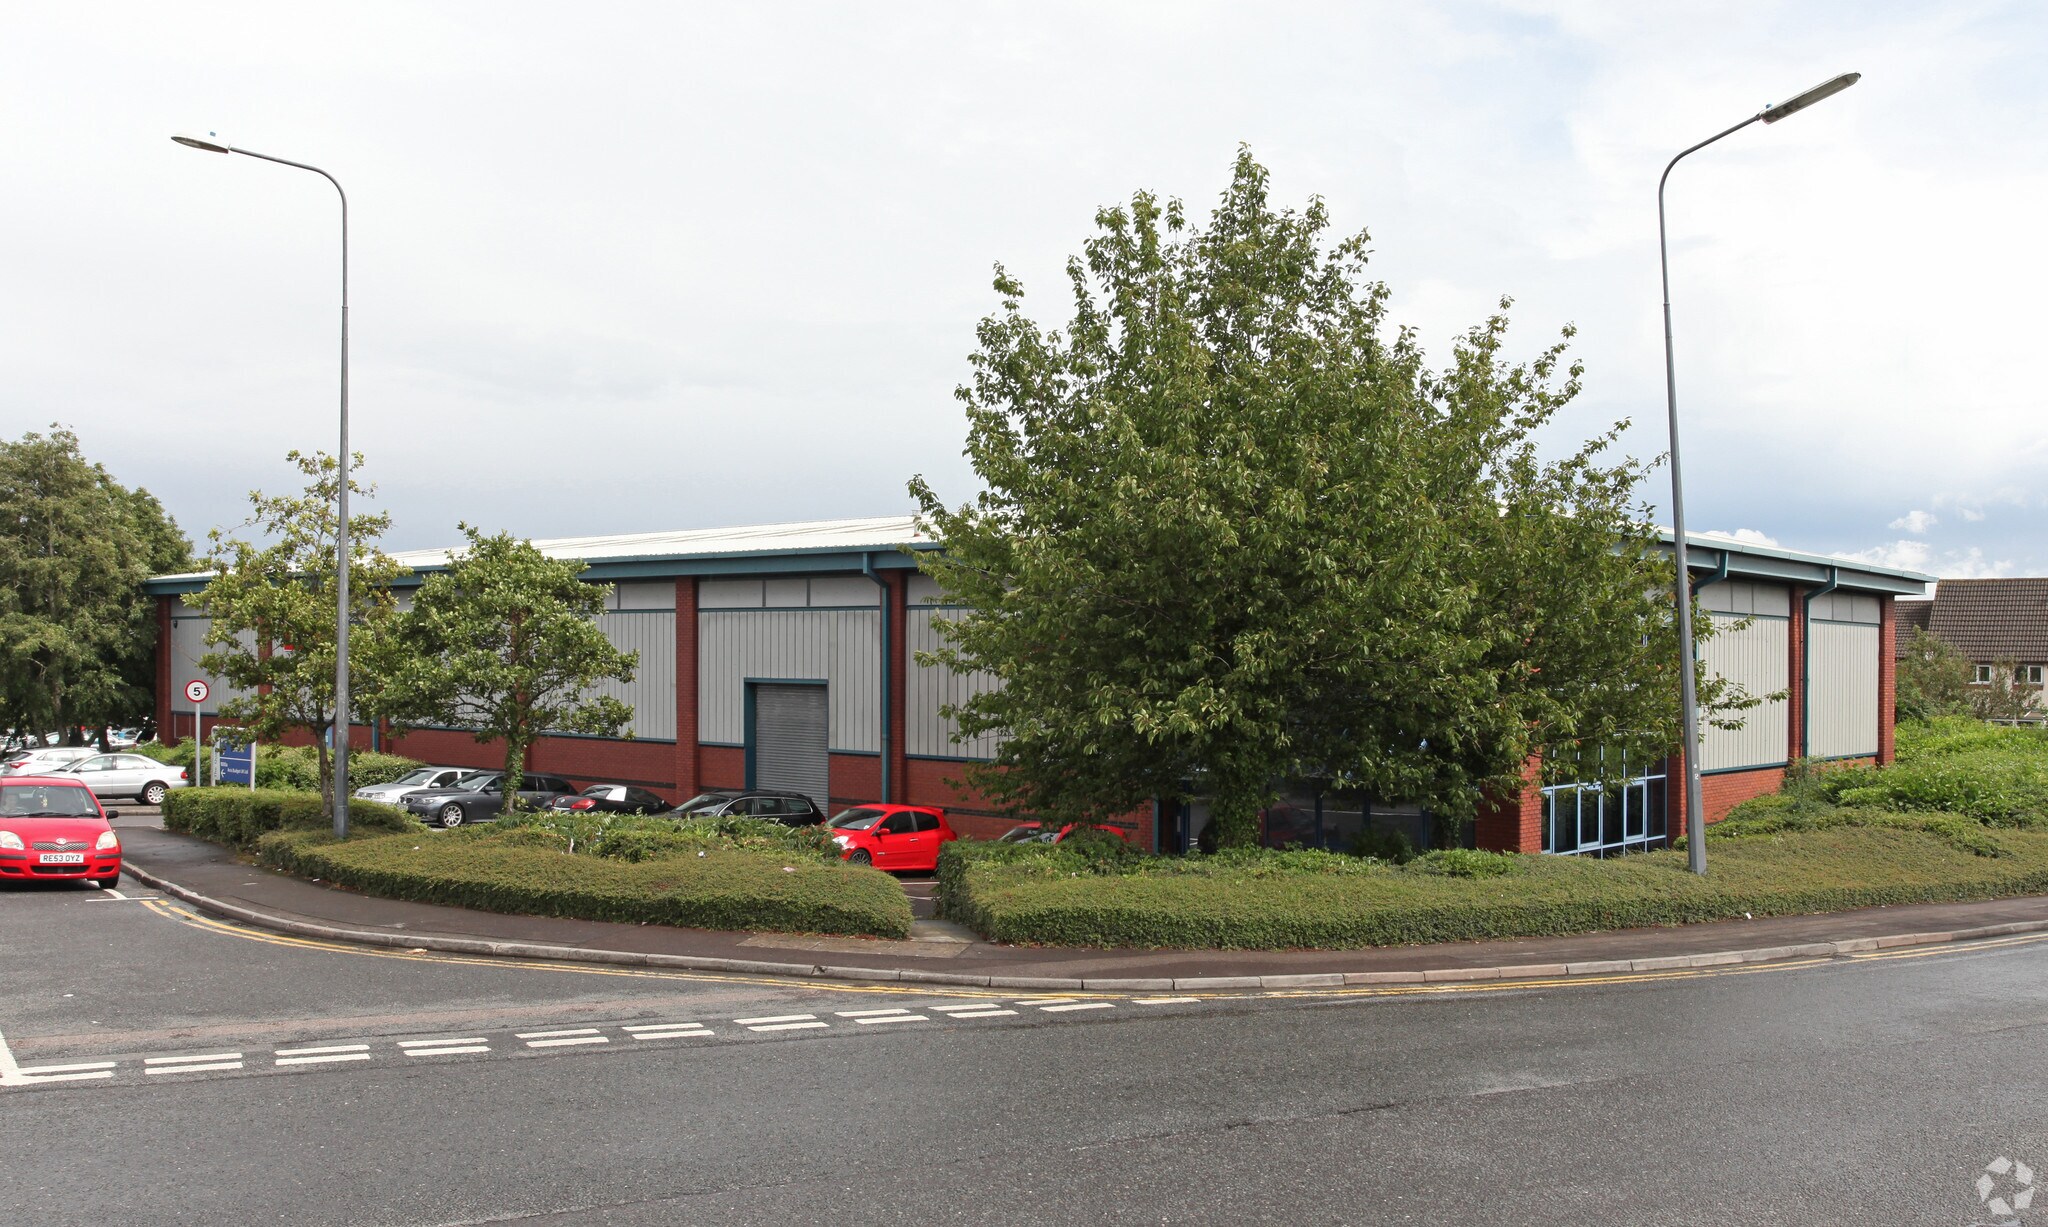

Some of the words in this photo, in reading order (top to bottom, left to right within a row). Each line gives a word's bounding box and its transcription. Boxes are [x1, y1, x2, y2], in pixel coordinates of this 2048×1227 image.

[193, 686, 201, 697] 5
[43, 854, 64, 862] RE53
[65, 854, 81, 862] OYZ
